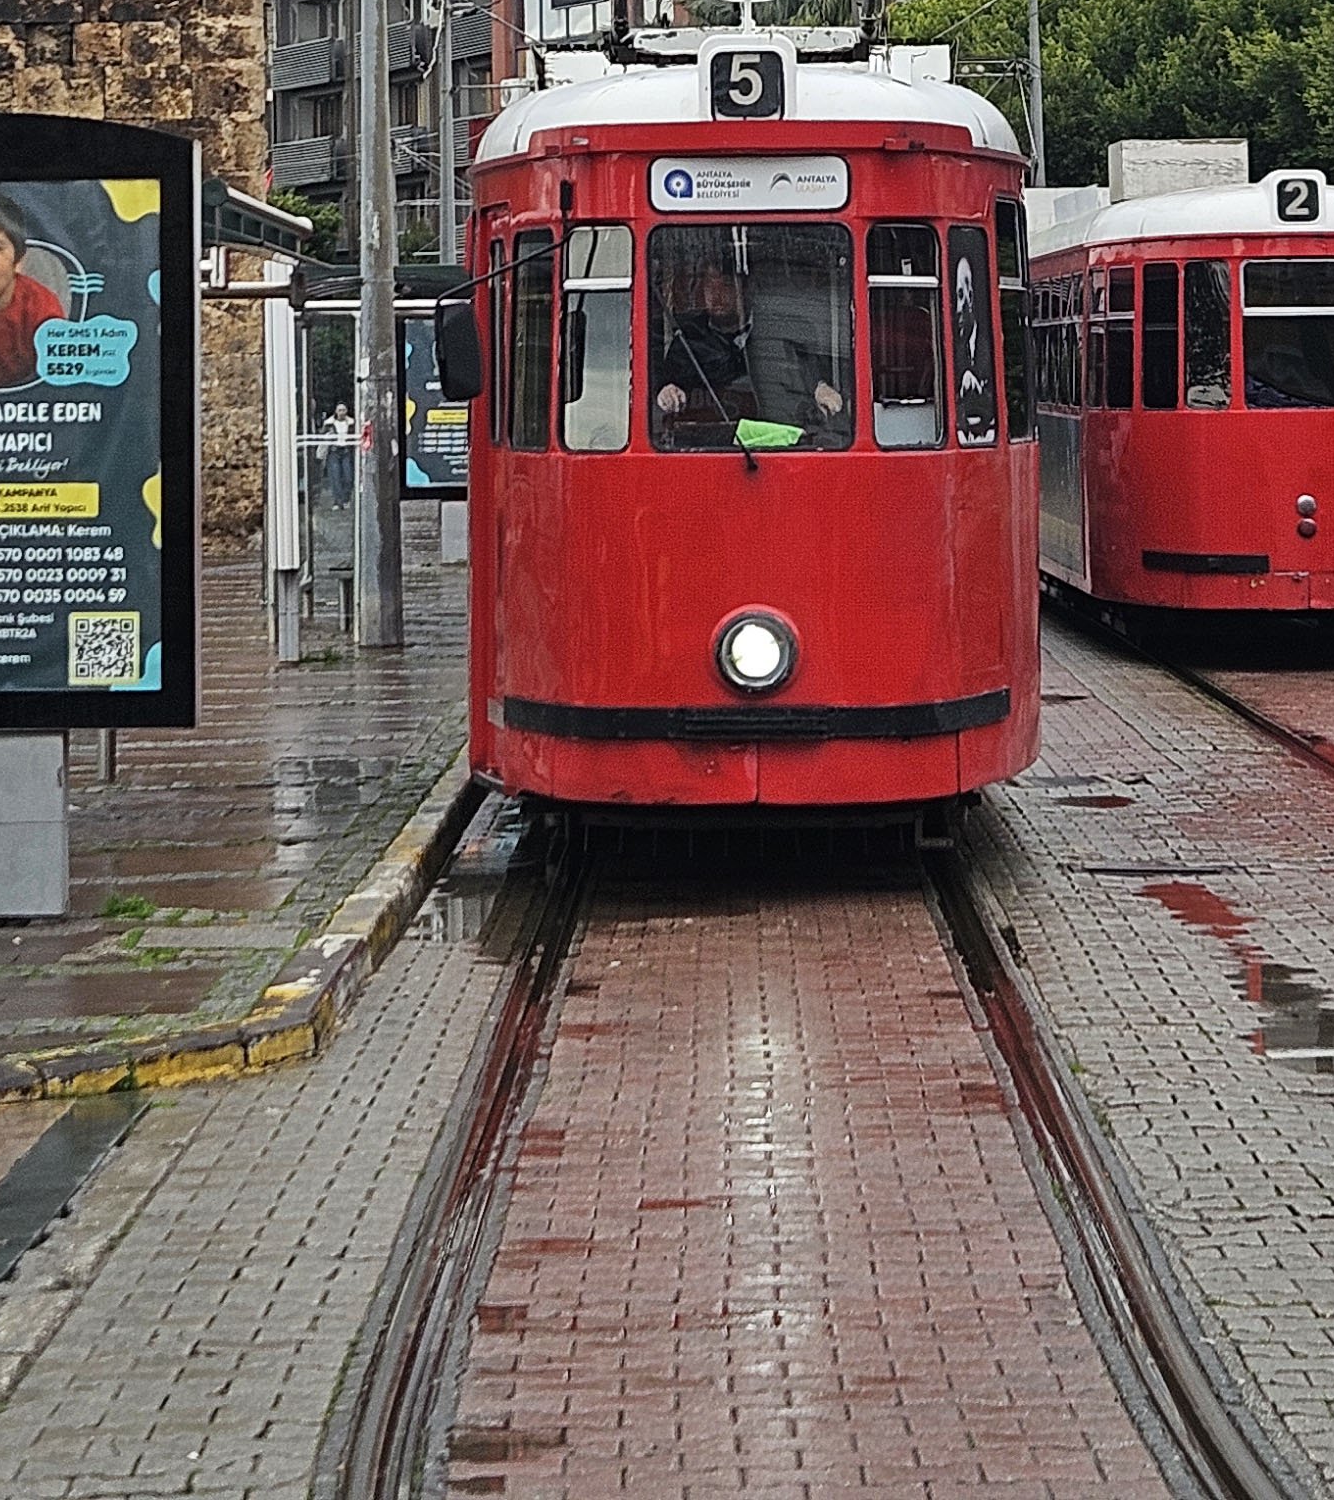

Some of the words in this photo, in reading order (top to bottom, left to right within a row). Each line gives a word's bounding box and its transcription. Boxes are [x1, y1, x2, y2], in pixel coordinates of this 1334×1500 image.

[728, 54, 763, 105] 5
[696, 171, 733, 179] ANTALYA
[796, 175, 837, 183] ANTALYA
[696, 178, 751, 189] BÜYÜKŞEHİR
[696, 189, 740, 199] BELEDİYESİ
[1284, 180, 1310, 216] 2
[47, 328, 66, 338] Her
[68, 328, 91, 338] SMS
[47, 344, 101, 357] KEREM
[47, 362, 85, 376] 5529
[52, 402, 102, 423] EDEN
[5, 457, 69, 479] Bekliyor!
[31, 503, 51, 513] Arif
[53, 504, 86, 514] Yapıcı
[67, 524, 112, 537] Kerem
[24, 547, 62, 562] 0001
[65, 546, 101, 561] 1083
[103, 546, 124, 561] 48
[25, 568, 64, 582] 0023
[66, 567, 107, 582] 0009
[109, 567, 127, 582] 31
[22, 588, 62, 603] 0035
[63, 588, 106, 603] 0004
[107, 588, 127, 603] 59
[17, 612, 55, 626] Şubesi
